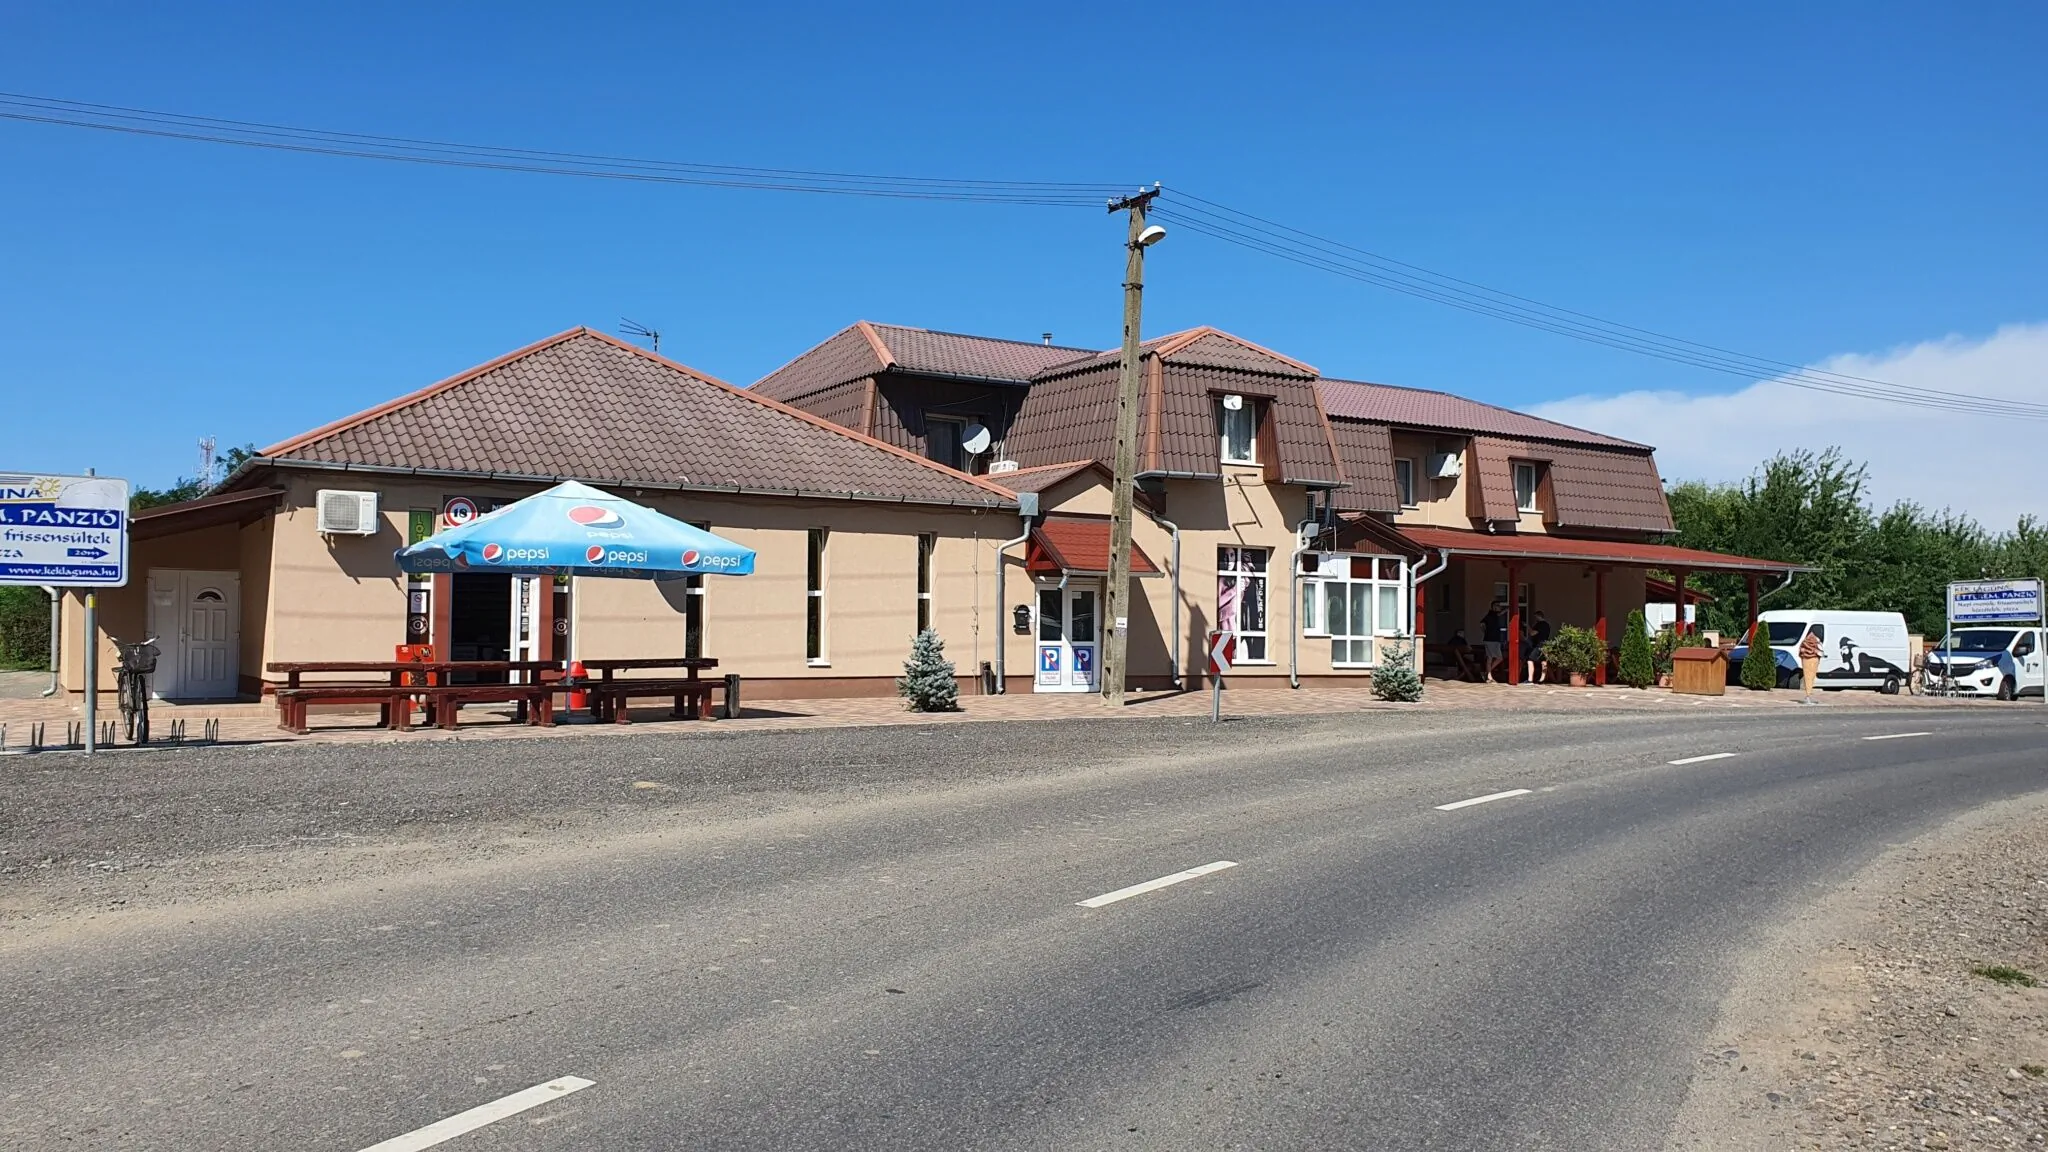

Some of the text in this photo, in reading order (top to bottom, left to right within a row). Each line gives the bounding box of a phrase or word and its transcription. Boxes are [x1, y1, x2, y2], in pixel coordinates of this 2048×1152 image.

[20, 509, 117, 526] PANZIÓ
[453, 508, 468, 518] 18
[4, 529, 111, 544] frissensültek
[586, 531, 634, 540] pepsi
[506, 546, 550, 562] pepsi
[608, 549, 648, 564] pepsi
[702, 553, 741, 568] pepsi
